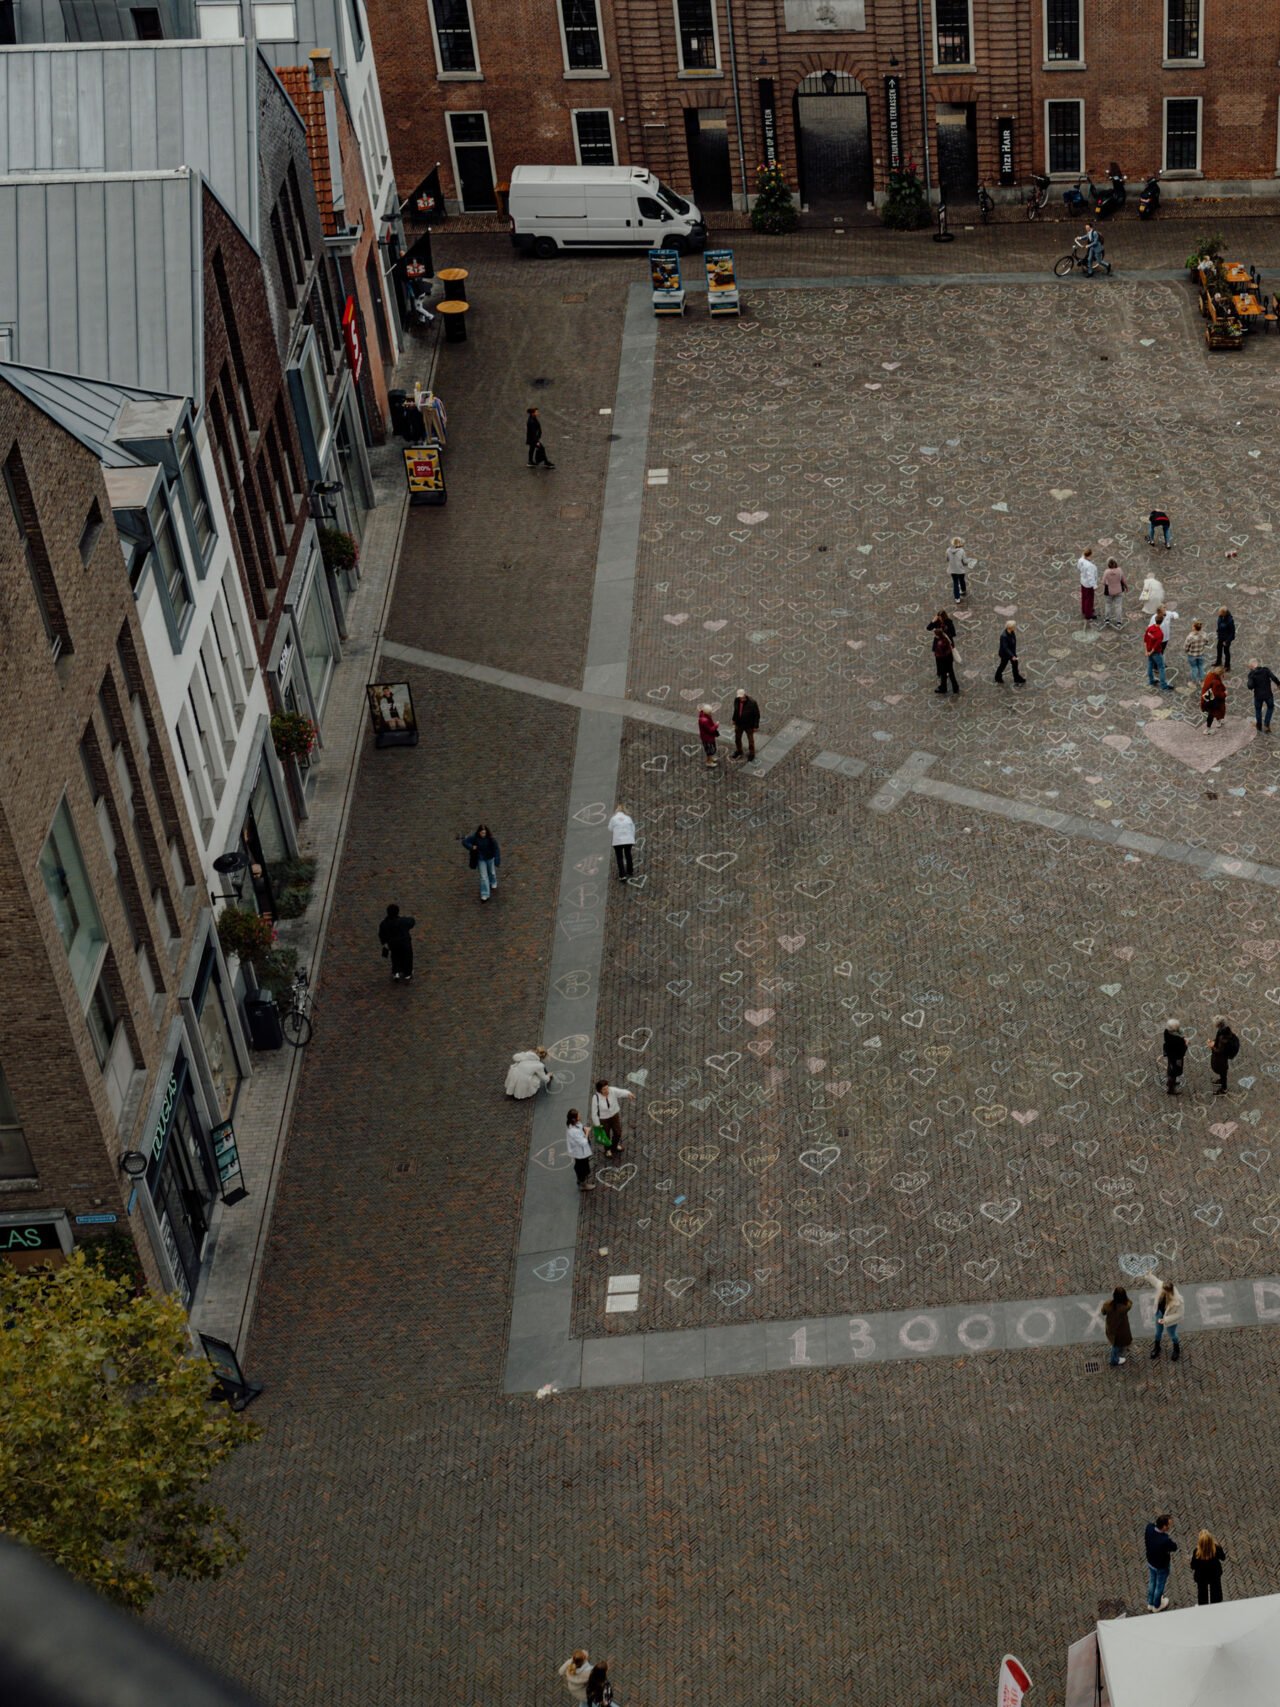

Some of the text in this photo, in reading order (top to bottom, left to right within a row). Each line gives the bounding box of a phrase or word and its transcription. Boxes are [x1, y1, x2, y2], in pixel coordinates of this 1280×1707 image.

[888, 88, 898, 120] TERRASSEN
[764, 108, 773, 125] PLEIN
[890, 121, 898, 129] EN
[765, 126, 774, 138] HET
[766, 138, 774, 146] OP
